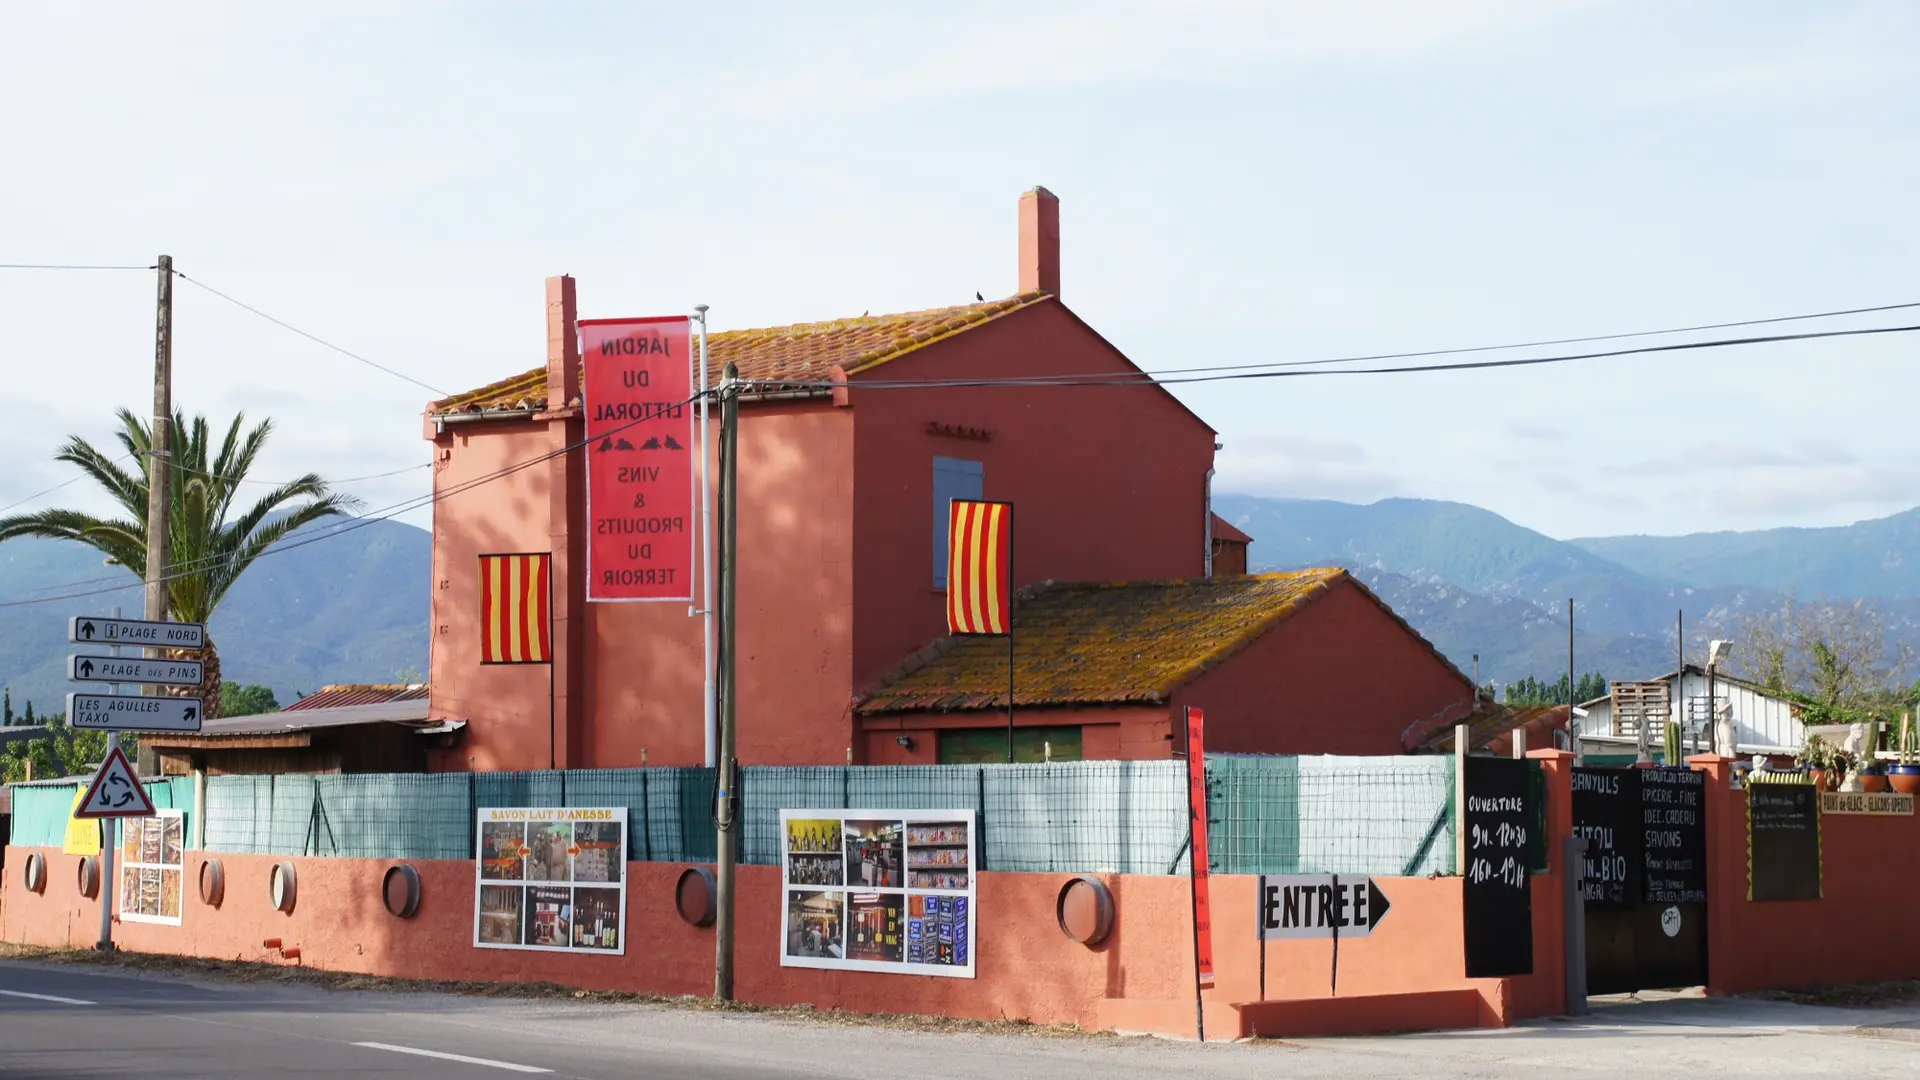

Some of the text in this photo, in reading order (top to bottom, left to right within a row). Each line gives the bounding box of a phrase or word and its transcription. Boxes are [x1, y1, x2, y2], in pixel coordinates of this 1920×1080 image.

[121, 627, 198, 641] PLAGE NORD
[102, 664, 141, 676] PLAGE
[168, 667, 197, 678] PINS
[79, 700, 160, 713] LES AGULLES
[78, 712, 109, 723] TAXO
[1571, 772, 1619, 795] BANYULS
[1469, 795, 1523, 813] OUVERTURE
[491, 809, 612, 820] SAVON LAIT D'ANESSE
[1645, 830, 1682, 848] SAVONS
[1265, 884, 1367, 929] ENTREE
